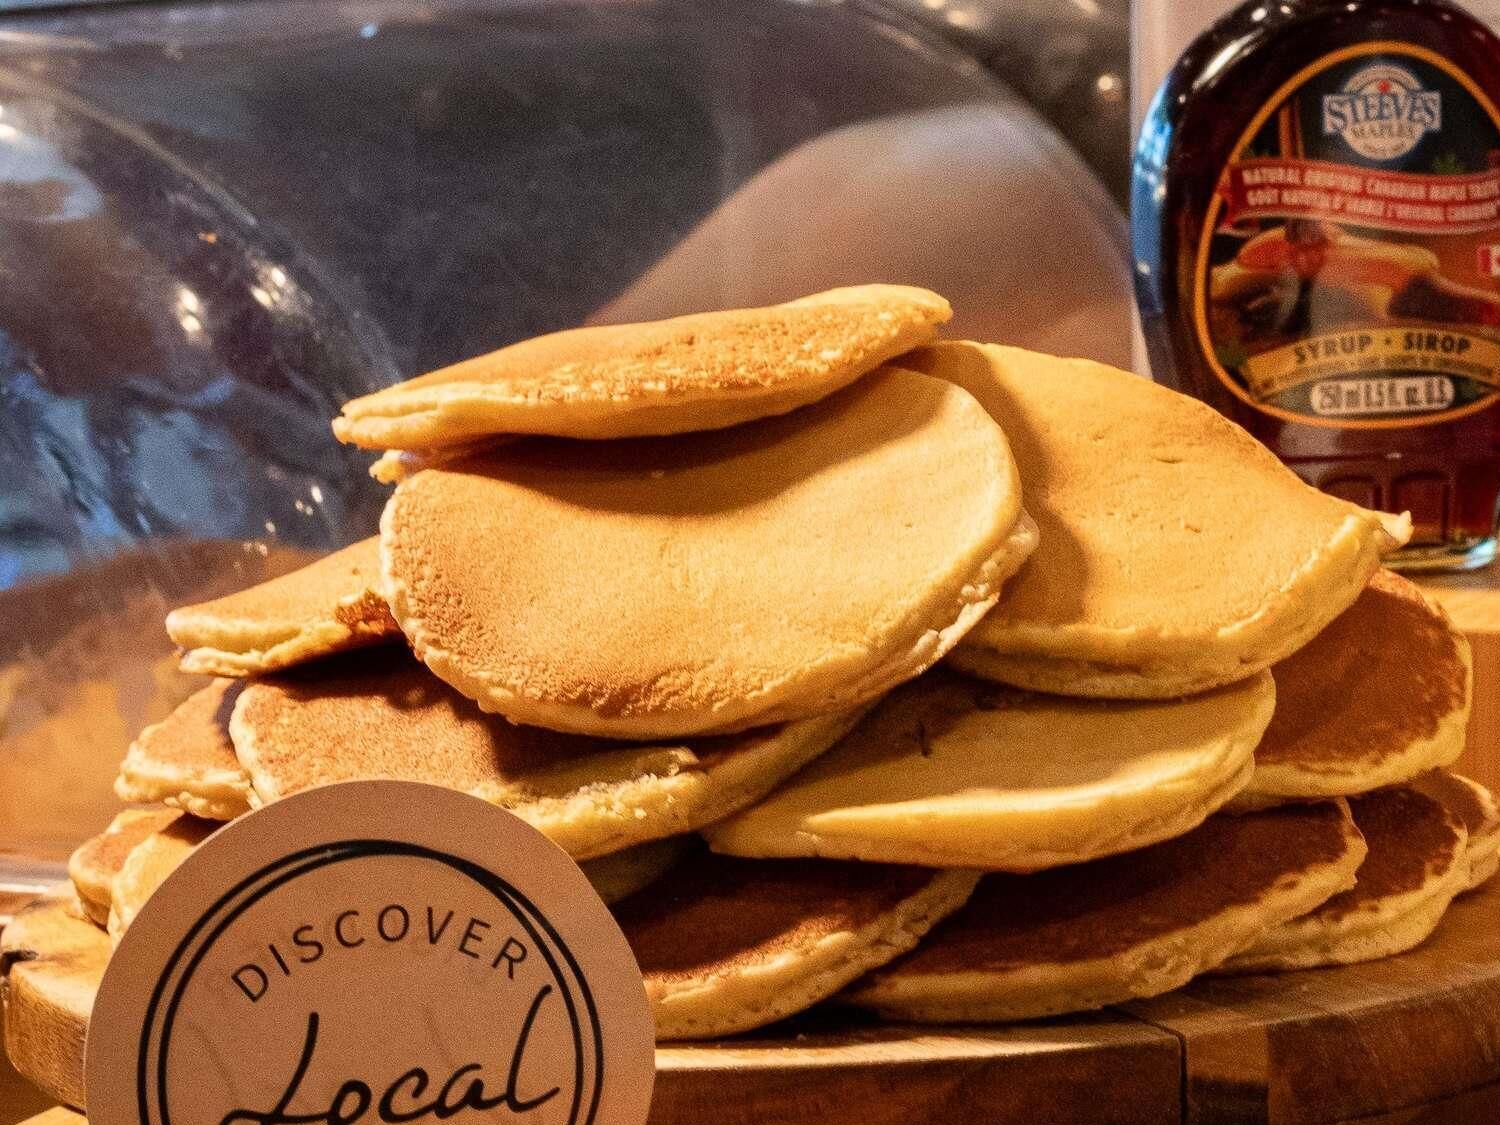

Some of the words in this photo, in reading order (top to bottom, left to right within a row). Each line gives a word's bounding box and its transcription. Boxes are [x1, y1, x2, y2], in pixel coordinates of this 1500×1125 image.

[1294, 335, 1373, 364] SYRUP
[1402, 332, 1472, 354] SIROP
[231, 904, 528, 1003] DISCOVER
